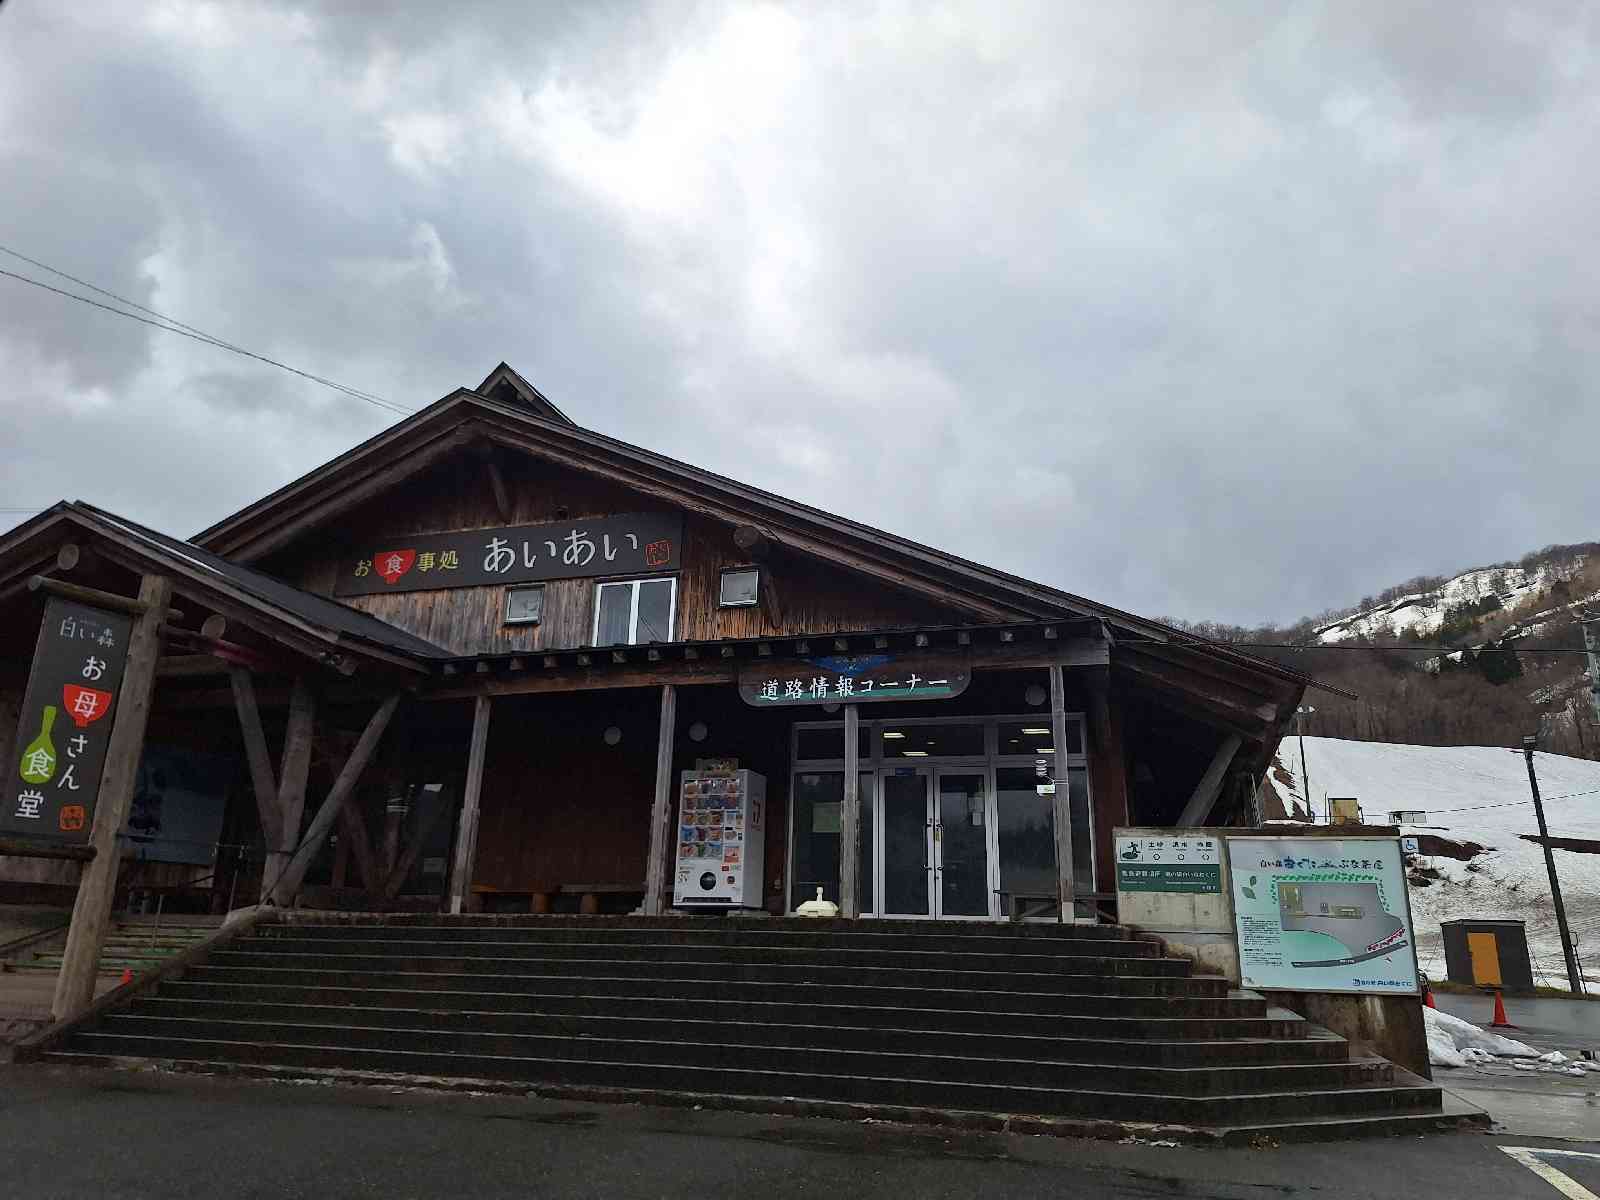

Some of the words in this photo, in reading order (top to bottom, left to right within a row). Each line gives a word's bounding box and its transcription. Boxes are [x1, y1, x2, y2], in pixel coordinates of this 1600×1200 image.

[354, 550, 460, 577] お食事処
[483, 529, 639, 574] あいあい
[60, 616, 115, 648] 白い森
[759, 673, 948, 701] 道路情報コーナー
[57, 655, 107, 790] お母さん
[15, 747, 55, 819] 食堂
